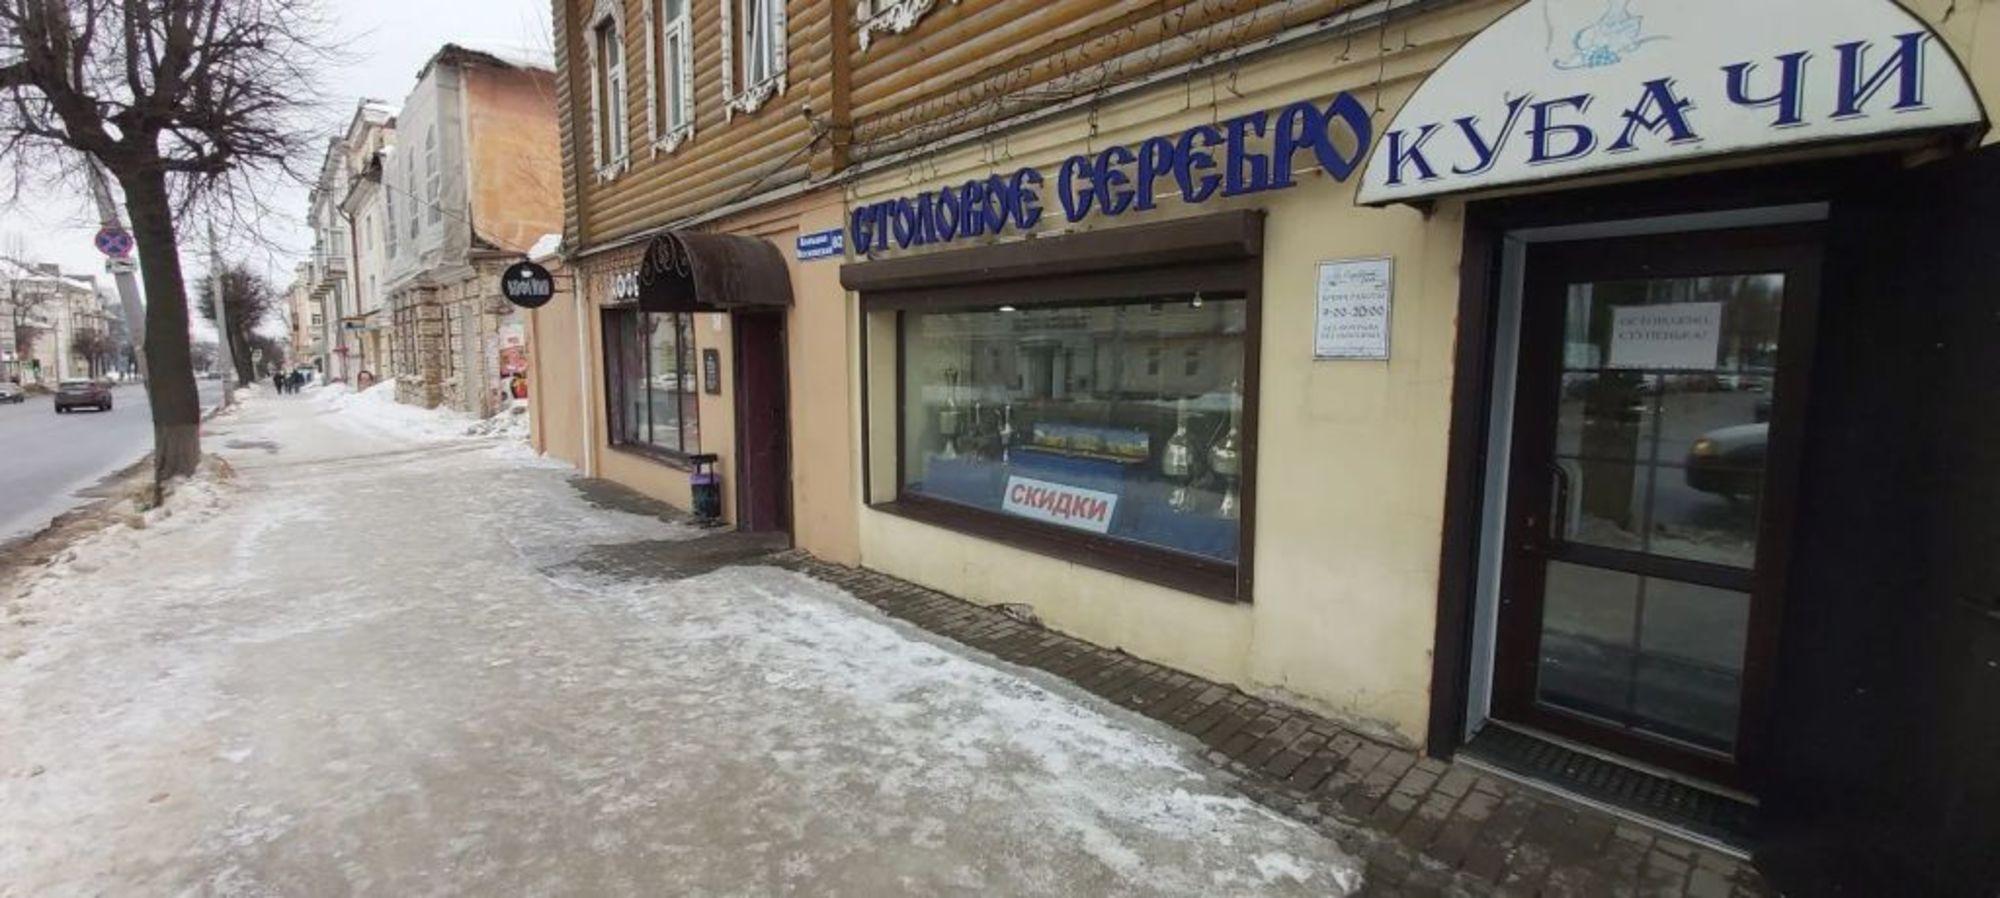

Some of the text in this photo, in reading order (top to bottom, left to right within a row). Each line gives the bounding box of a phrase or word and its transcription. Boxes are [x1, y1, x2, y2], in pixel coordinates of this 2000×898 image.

[850, 90, 1373, 256] СТОЛОВОЕ СЕРЕБРО
[1383, 30, 1932, 187] КУБАЧИ
[1011, 483, 1108, 520] СКИДКИ
